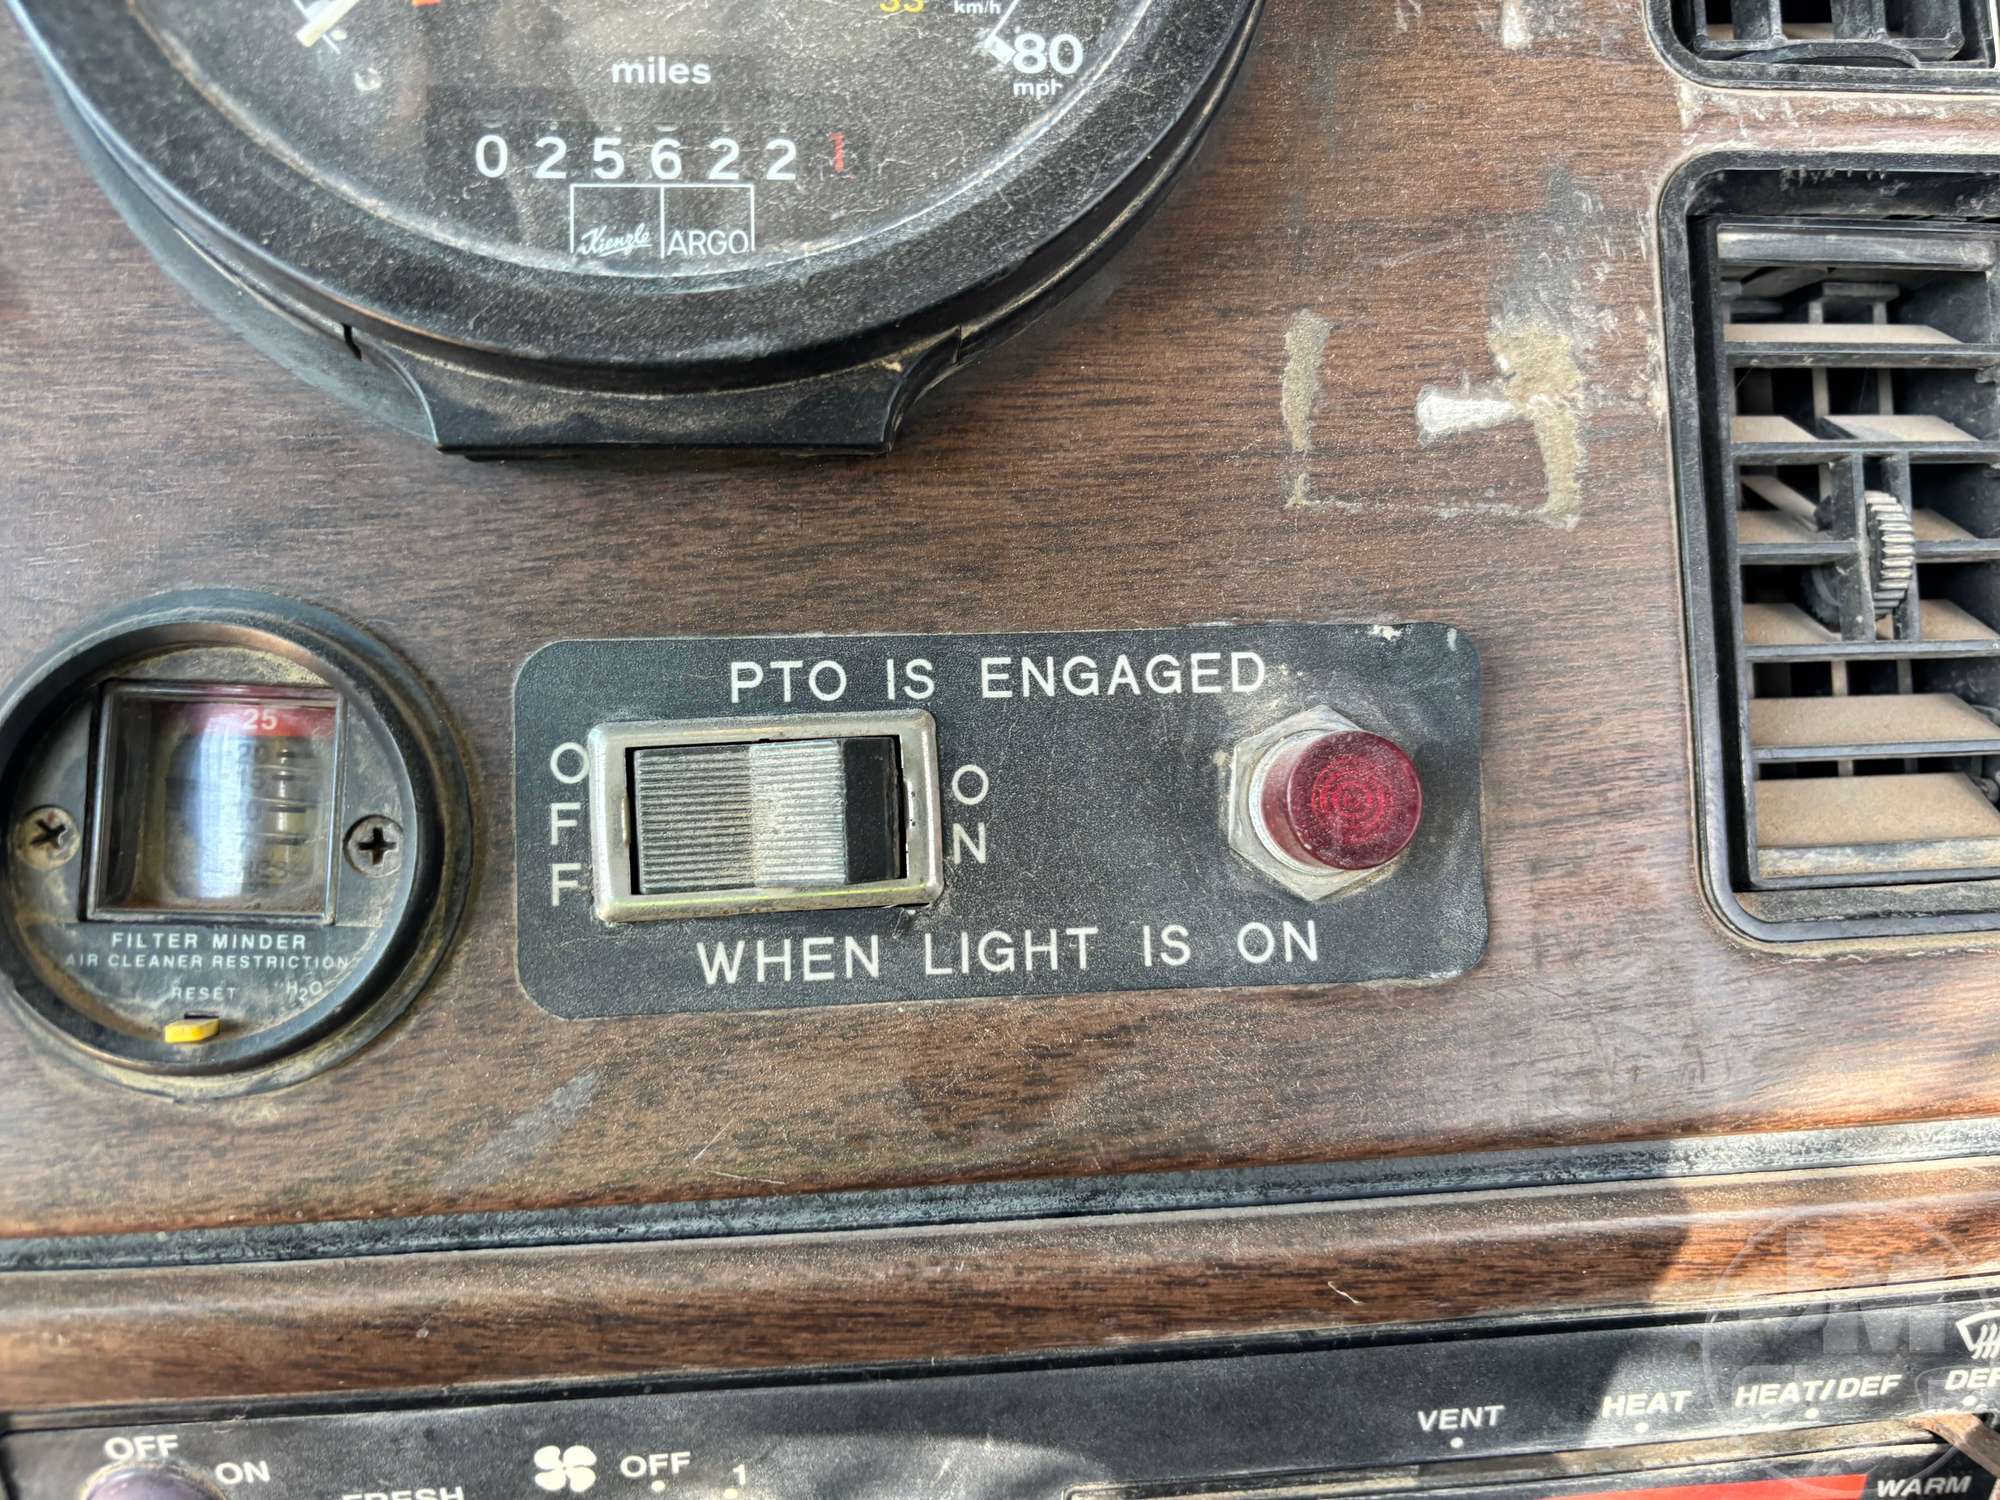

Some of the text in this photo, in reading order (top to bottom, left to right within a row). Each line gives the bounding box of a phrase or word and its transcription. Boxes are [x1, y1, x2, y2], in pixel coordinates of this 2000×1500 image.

[953, 0, 1001, 14] km/h
[1013, 33, 1083, 74] 80
[611, 55, 711, 84] miles
[667, 230, 749, 256] ARGO
[730, 650, 1266, 703] PTO IS ENGAGED
[243, 707, 278, 730] 25
[111, 931, 307, 950] FILTER MINDER
[697, 919, 1319, 985] WHEN LIGHT IS ON
[64, 953, 350, 970] AIR CLEANER RESTRICTION
[171, 986, 237, 1001] RESET
[1601, 1390, 1693, 1418] HEAT
[1734, 1373, 1903, 1408] HEAT/DEF
[1417, 1404, 1505, 1432] VENT
[103, 1434, 179, 1462] OFF
[214, 1460, 271, 1485] ON
[619, 1451, 692, 1479] OFF
[733, 1463, 748, 1486] 1
[1875, 1475, 1973, 1498] WARM
